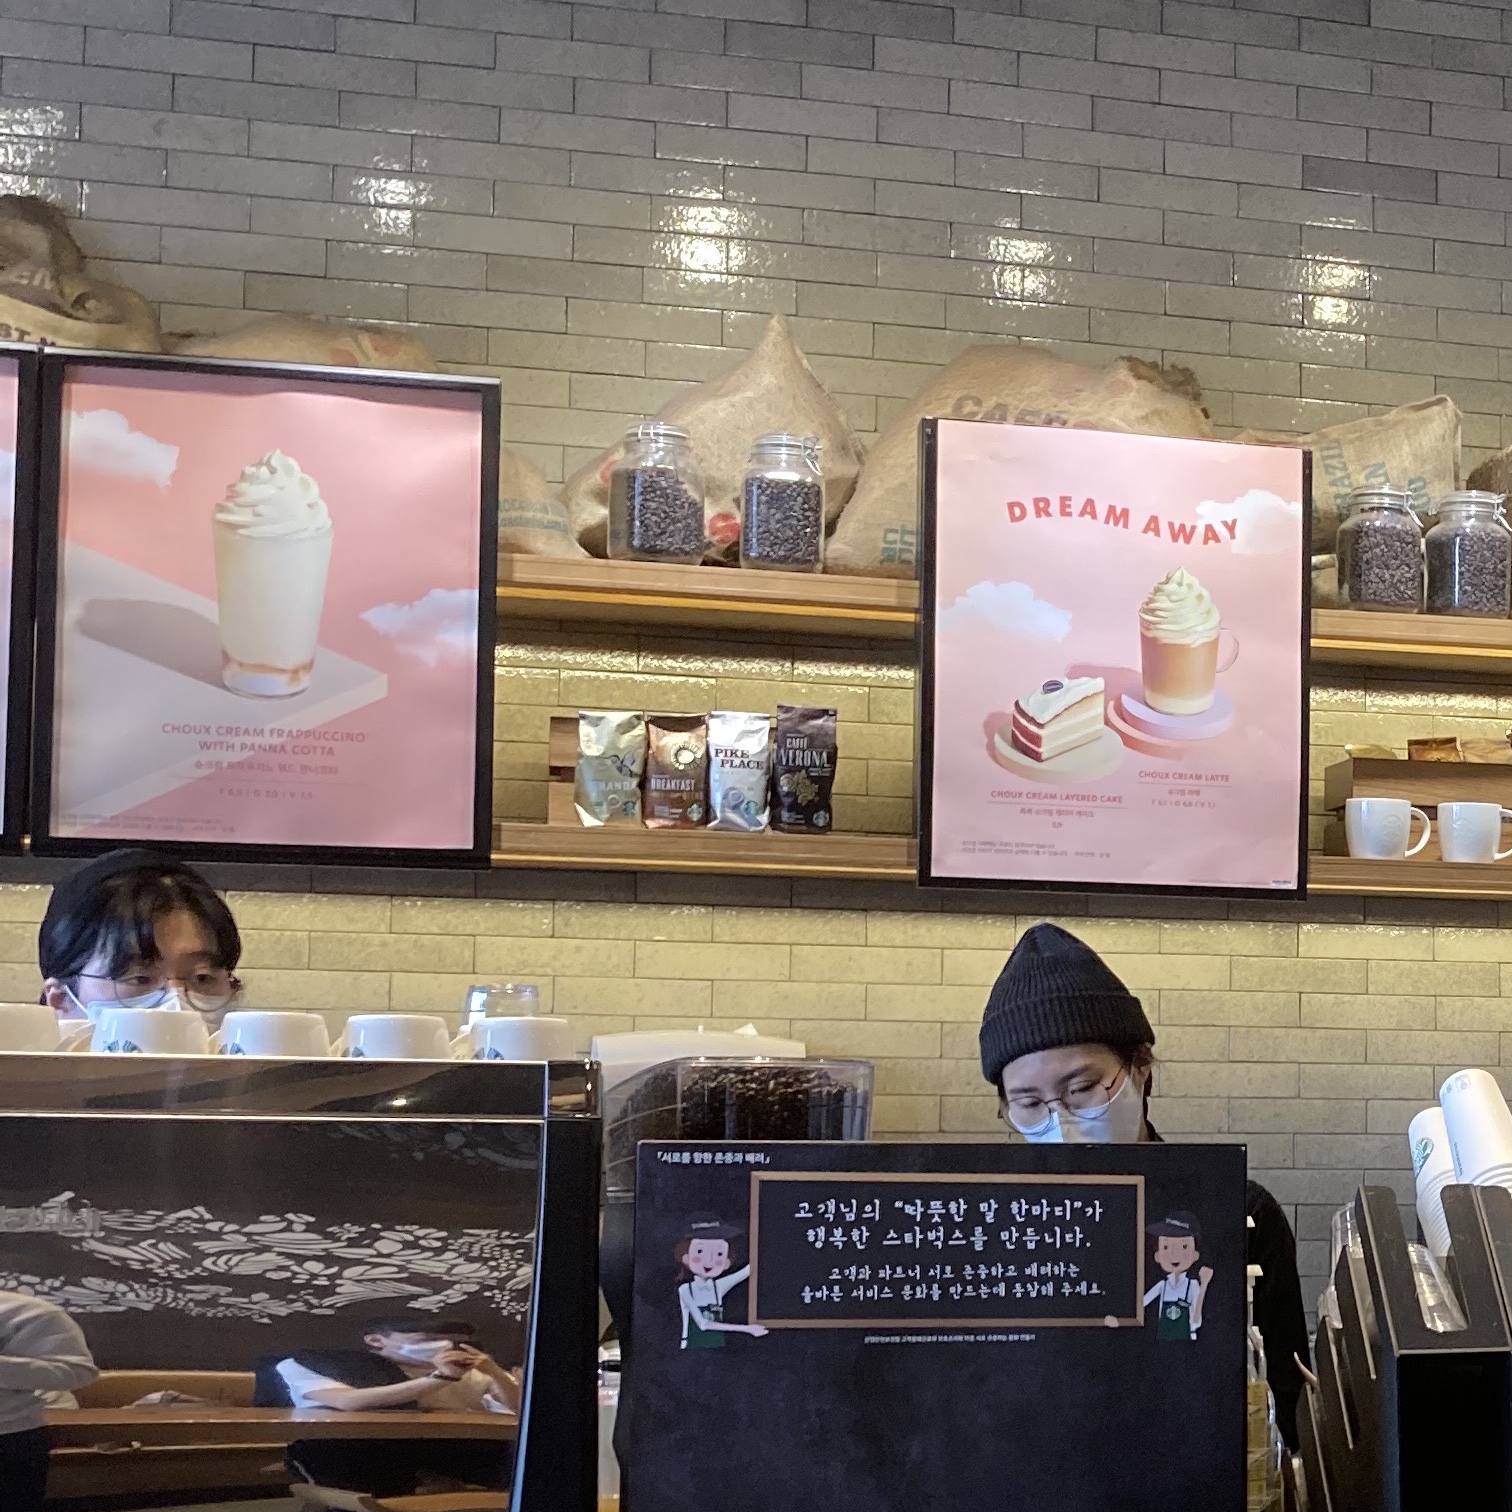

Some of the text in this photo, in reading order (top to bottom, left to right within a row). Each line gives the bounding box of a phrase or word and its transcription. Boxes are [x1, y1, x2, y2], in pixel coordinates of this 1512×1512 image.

[1006, 494, 1239, 546] DREAM AWAY
[162, 723, 366, 743] CHOUX CREAM FRAPPUCCINO
[198, 741, 336, 757] WITH PANNA COTTA
[714, 748, 749, 759] PIKE
[720, 759, 764, 770] PLACE
[650, 778, 695, 791] BREAKFAST
[1138, 770, 1230, 783] CHOUX CREAM LATTE
[990, 789, 1123, 804] CHOUX CREAM LAYERED CAKE
[794, 1199, 880, 1222] 고객님의
[979, 1198, 998, 1223] 말
[806, 1225, 1091, 1251] 행복한 스타벅스를 만듭니다.
[828, 1261, 1080, 1282] 고객과 파트너 서로 존중하고 배려하는
[851, 1284, 894, 1301] 서비스
[901, 1283, 942, 1301] 문화를
[949, 1282, 1006, 1300] 만드는데
[1012, 1281, 1054, 1298] 동참해
[1061, 1281, 1106, 1297] 주세요.
